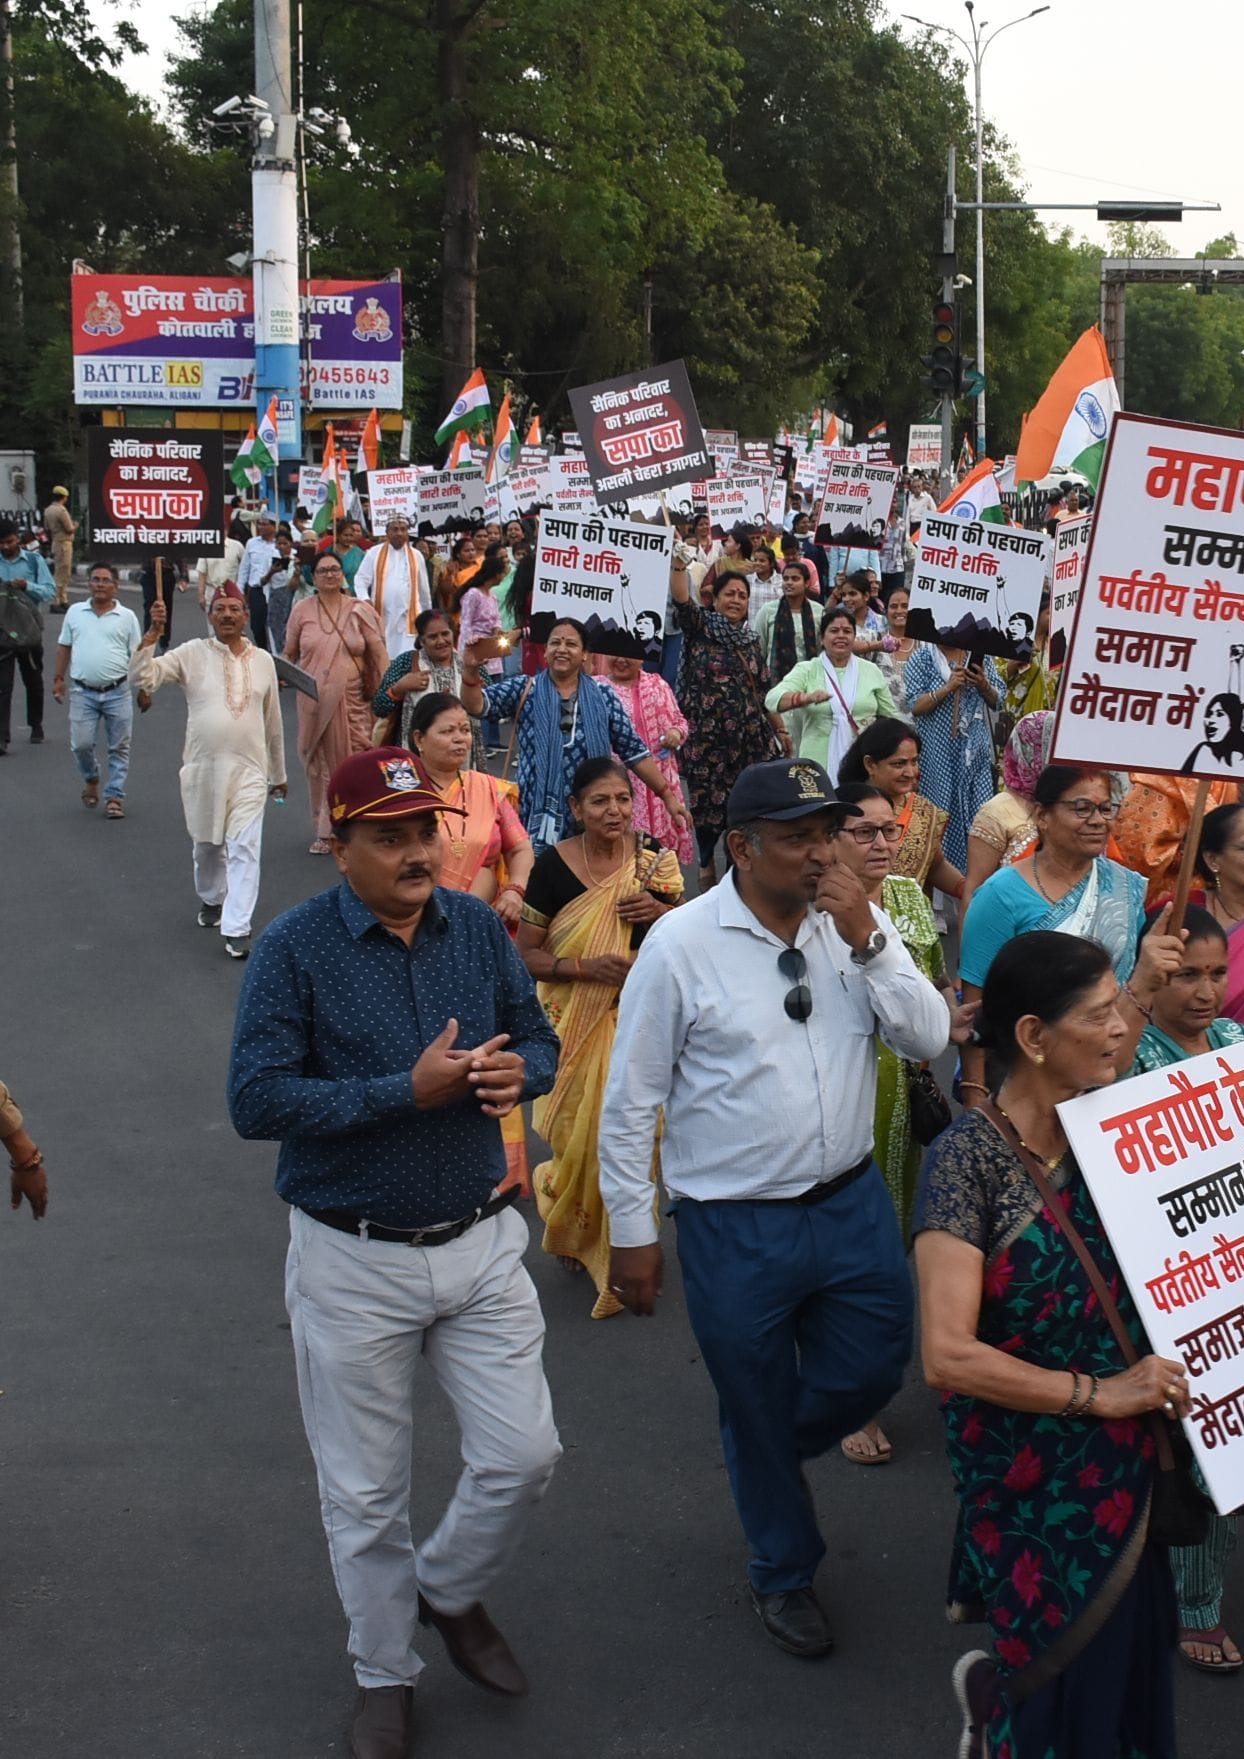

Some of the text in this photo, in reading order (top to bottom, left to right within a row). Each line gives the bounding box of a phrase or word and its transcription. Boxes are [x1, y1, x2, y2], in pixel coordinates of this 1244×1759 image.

[122, 285, 247, 316] पुलिस चौकी
[157, 317, 237, 339] कोतवाली
[84, 364, 201, 384] BATTLE IAS
[83, 389, 118, 400] PURANIA
[314, 388, 376, 400] Battle IAS
[590, 379, 671, 413] सैनिक परिवार
[604, 402, 668, 430] का अनादर,
[109, 439, 202, 459] सैनिक परिवार
[601, 432, 653, 466] सपा
[647, 420, 684, 452] का
[119, 466, 192, 484] का अनादर,
[375, 469, 413, 486] महापौर
[420, 475, 438, 487] सपा
[440, 471, 452, 483] की
[596, 468, 633, 492] असली
[633, 463, 662, 482] चेहरा
[662, 450, 706, 472] उजागर।
[832, 463, 896, 485] सपा की पहचान,
[420, 484, 463, 500] नारी शक्ति
[708, 481, 724, 491] सपा
[724, 479, 734, 490] की
[709, 490, 745, 504] नारी शक्ति
[828, 481, 870, 498] नारी शक्ति
[109, 488, 203, 520] सपा का
[420, 501, 458, 513] का अपमान
[824, 502, 863, 515] का अपमान
[93, 524, 220, 545] असली चेहरा उजागर।
[544, 518, 669, 557] सपा की पहचान,
[926, 518, 1046, 562] सपा की पहचान,
[1058, 526, 1079, 551] सपा
[541, 545, 623, 575] नारी शक्ति
[921, 545, 1000, 577] नारी शक्ति
[1056, 551, 1079, 581] नारी
[539, 577, 614, 603] का अपमान
[917, 575, 990, 604] का अपमान
[1054, 593, 1065, 611] का
[1098, 570, 1190, 618] पर्वतीय
[1095, 626, 1197, 672] समाज
[1070, 672, 1205, 730] मैदान में
[1099, 1069, 1235, 1176] महापौर
[1145, 1249, 1222, 1315] पर्वतीय
